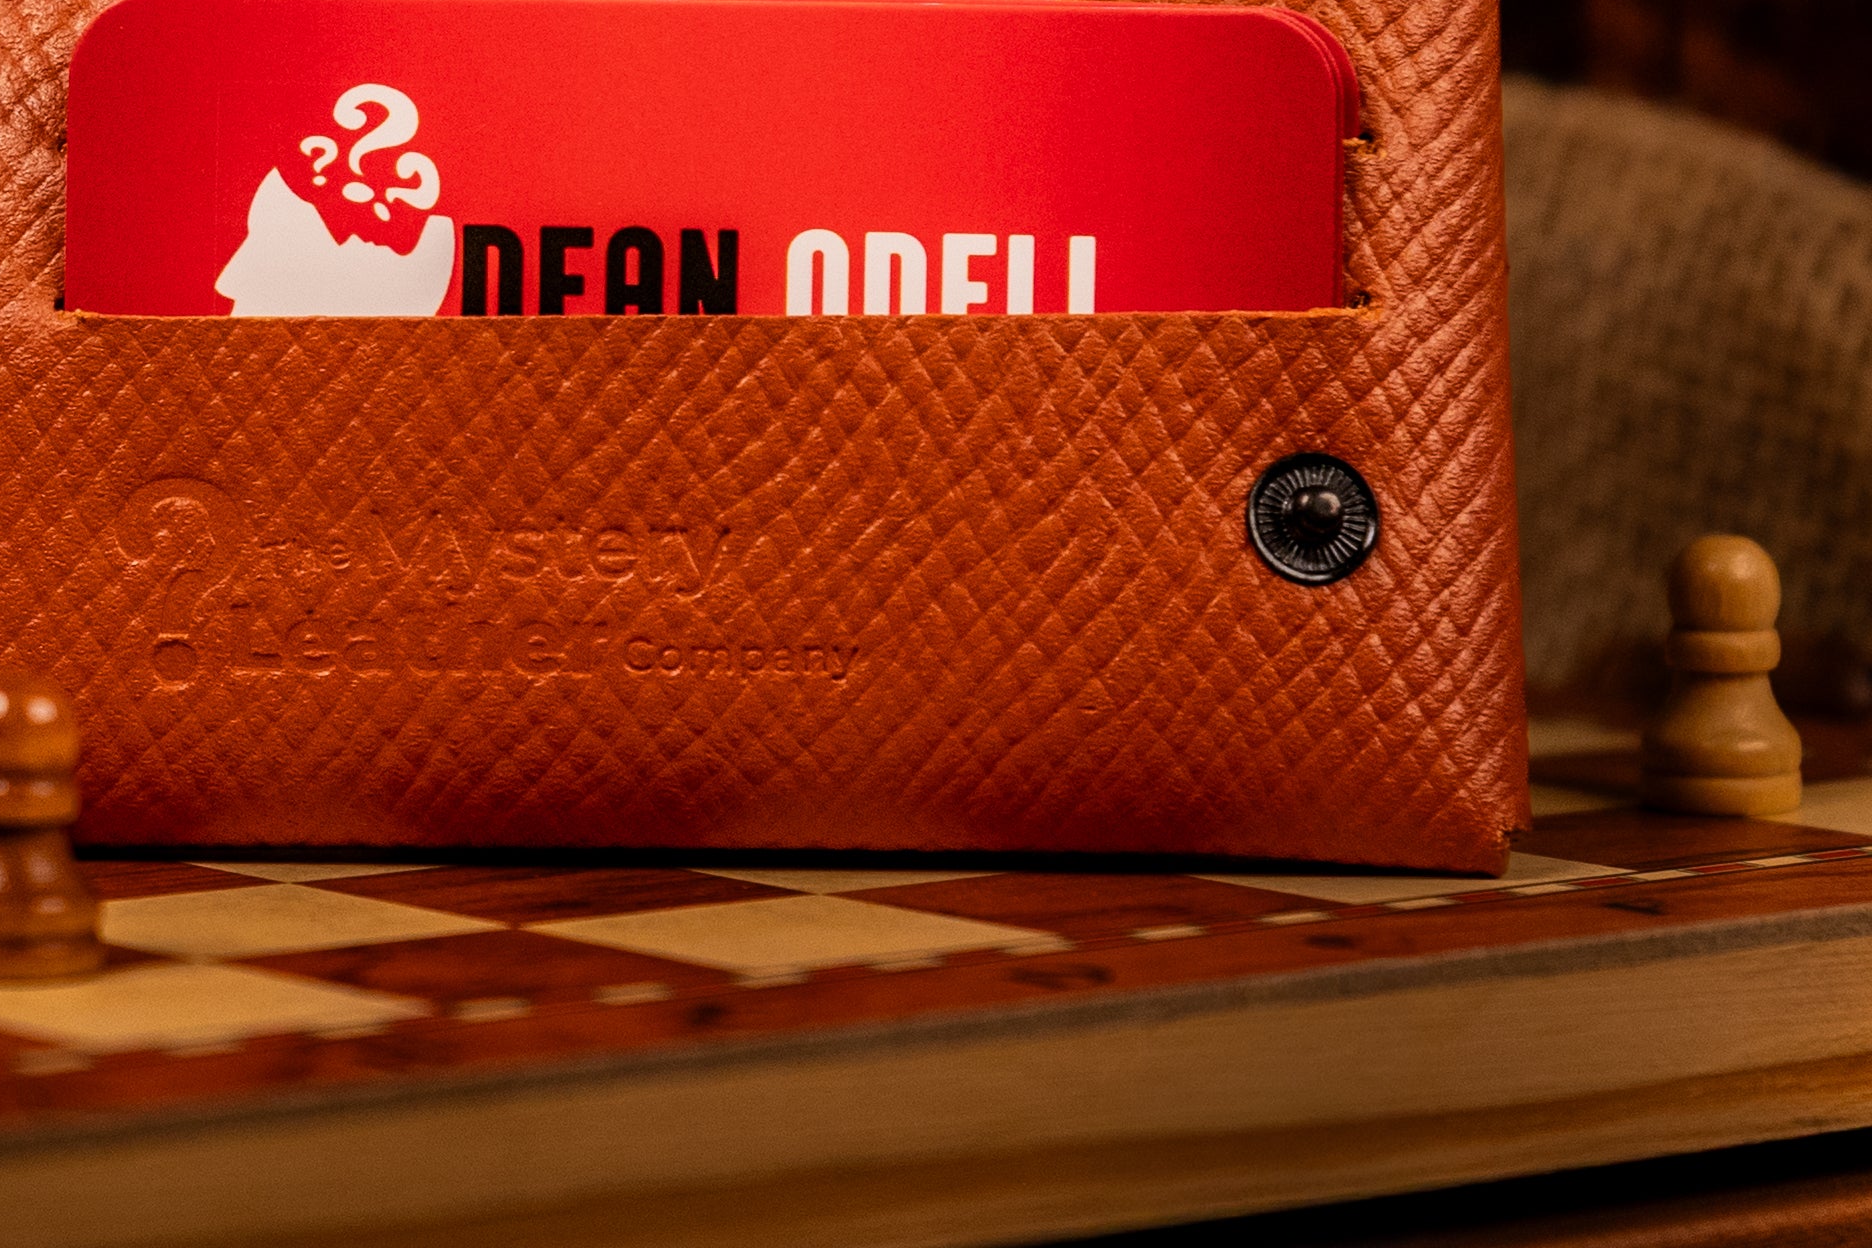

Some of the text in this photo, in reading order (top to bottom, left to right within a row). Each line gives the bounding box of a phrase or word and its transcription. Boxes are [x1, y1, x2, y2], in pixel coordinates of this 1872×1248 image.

[461, 225, 739, 316] DEAN
[364, 506, 732, 601] Mystery
[622, 634, 861, 682] Company
